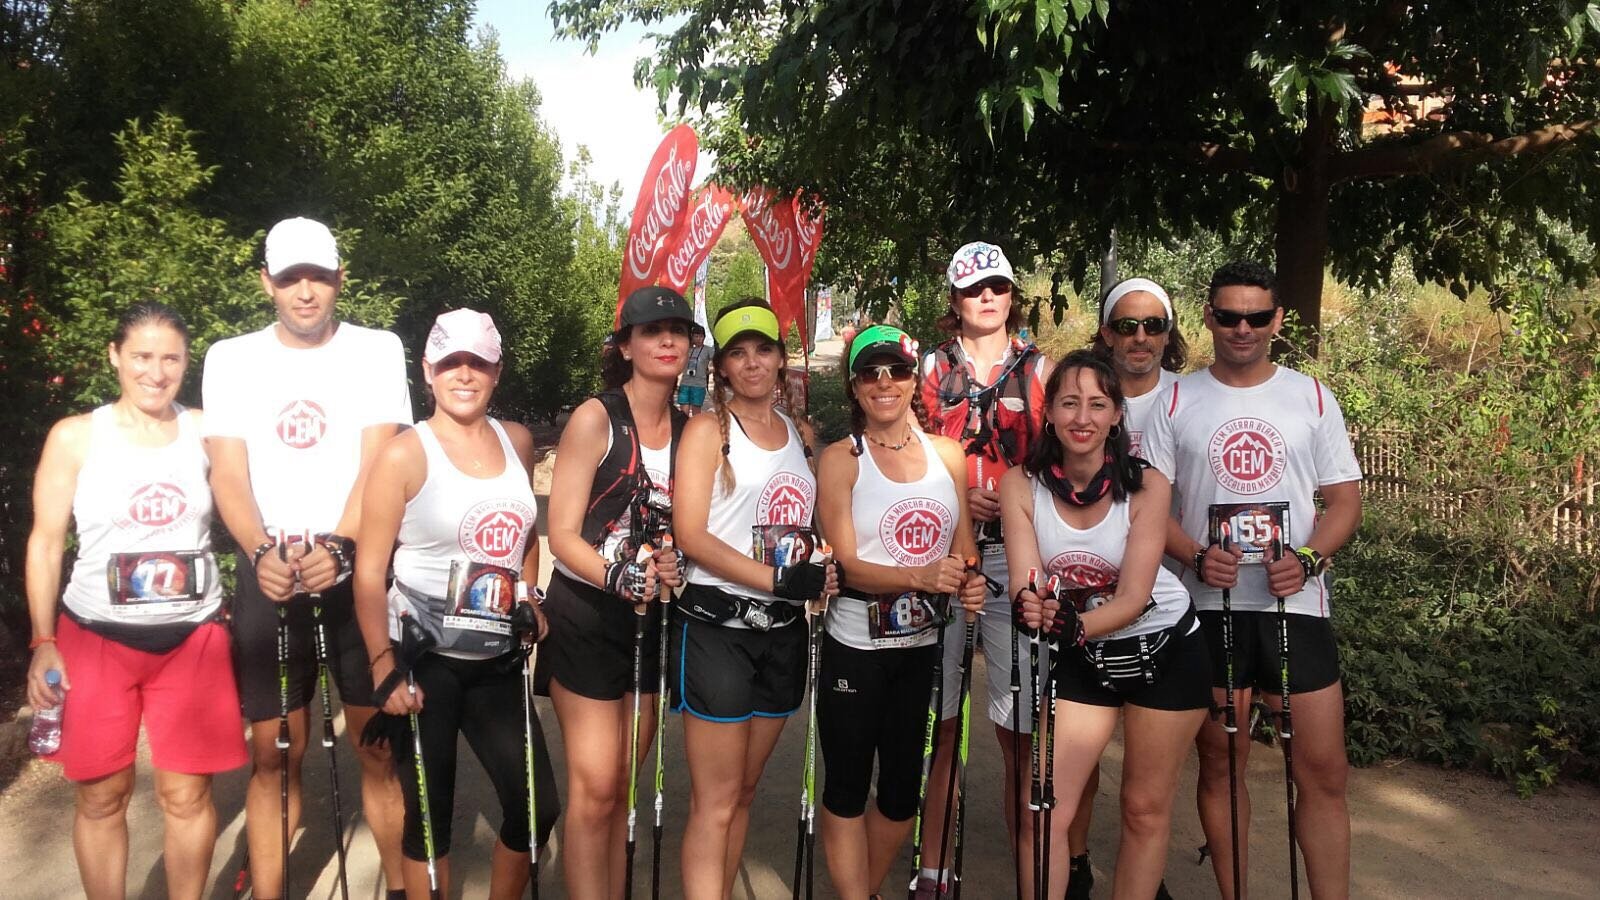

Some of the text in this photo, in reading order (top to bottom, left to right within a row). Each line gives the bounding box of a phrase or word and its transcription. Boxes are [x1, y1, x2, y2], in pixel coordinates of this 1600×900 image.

[283, 416, 321, 444] CEM
[1214, 420, 1283, 447] CEM SIERRA BLANCA
[1212, 455, 1284, 492] CLUB ESCALADA MARBELLA
[1229, 449, 1265, 474] CEM
[135, 497, 180, 521] CEM
[883, 514, 897, 529] CEM
[894, 500, 924, 516] MARCHA
[482, 527, 516, 551] CEM
[902, 525, 934, 549] CEM
[1230, 514, 1272, 543] 155
[885, 534, 947, 567] CLUB ESCALADA MARBELLA
[484, 577, 502, 609] 11
[896, 596, 926, 626] 85
